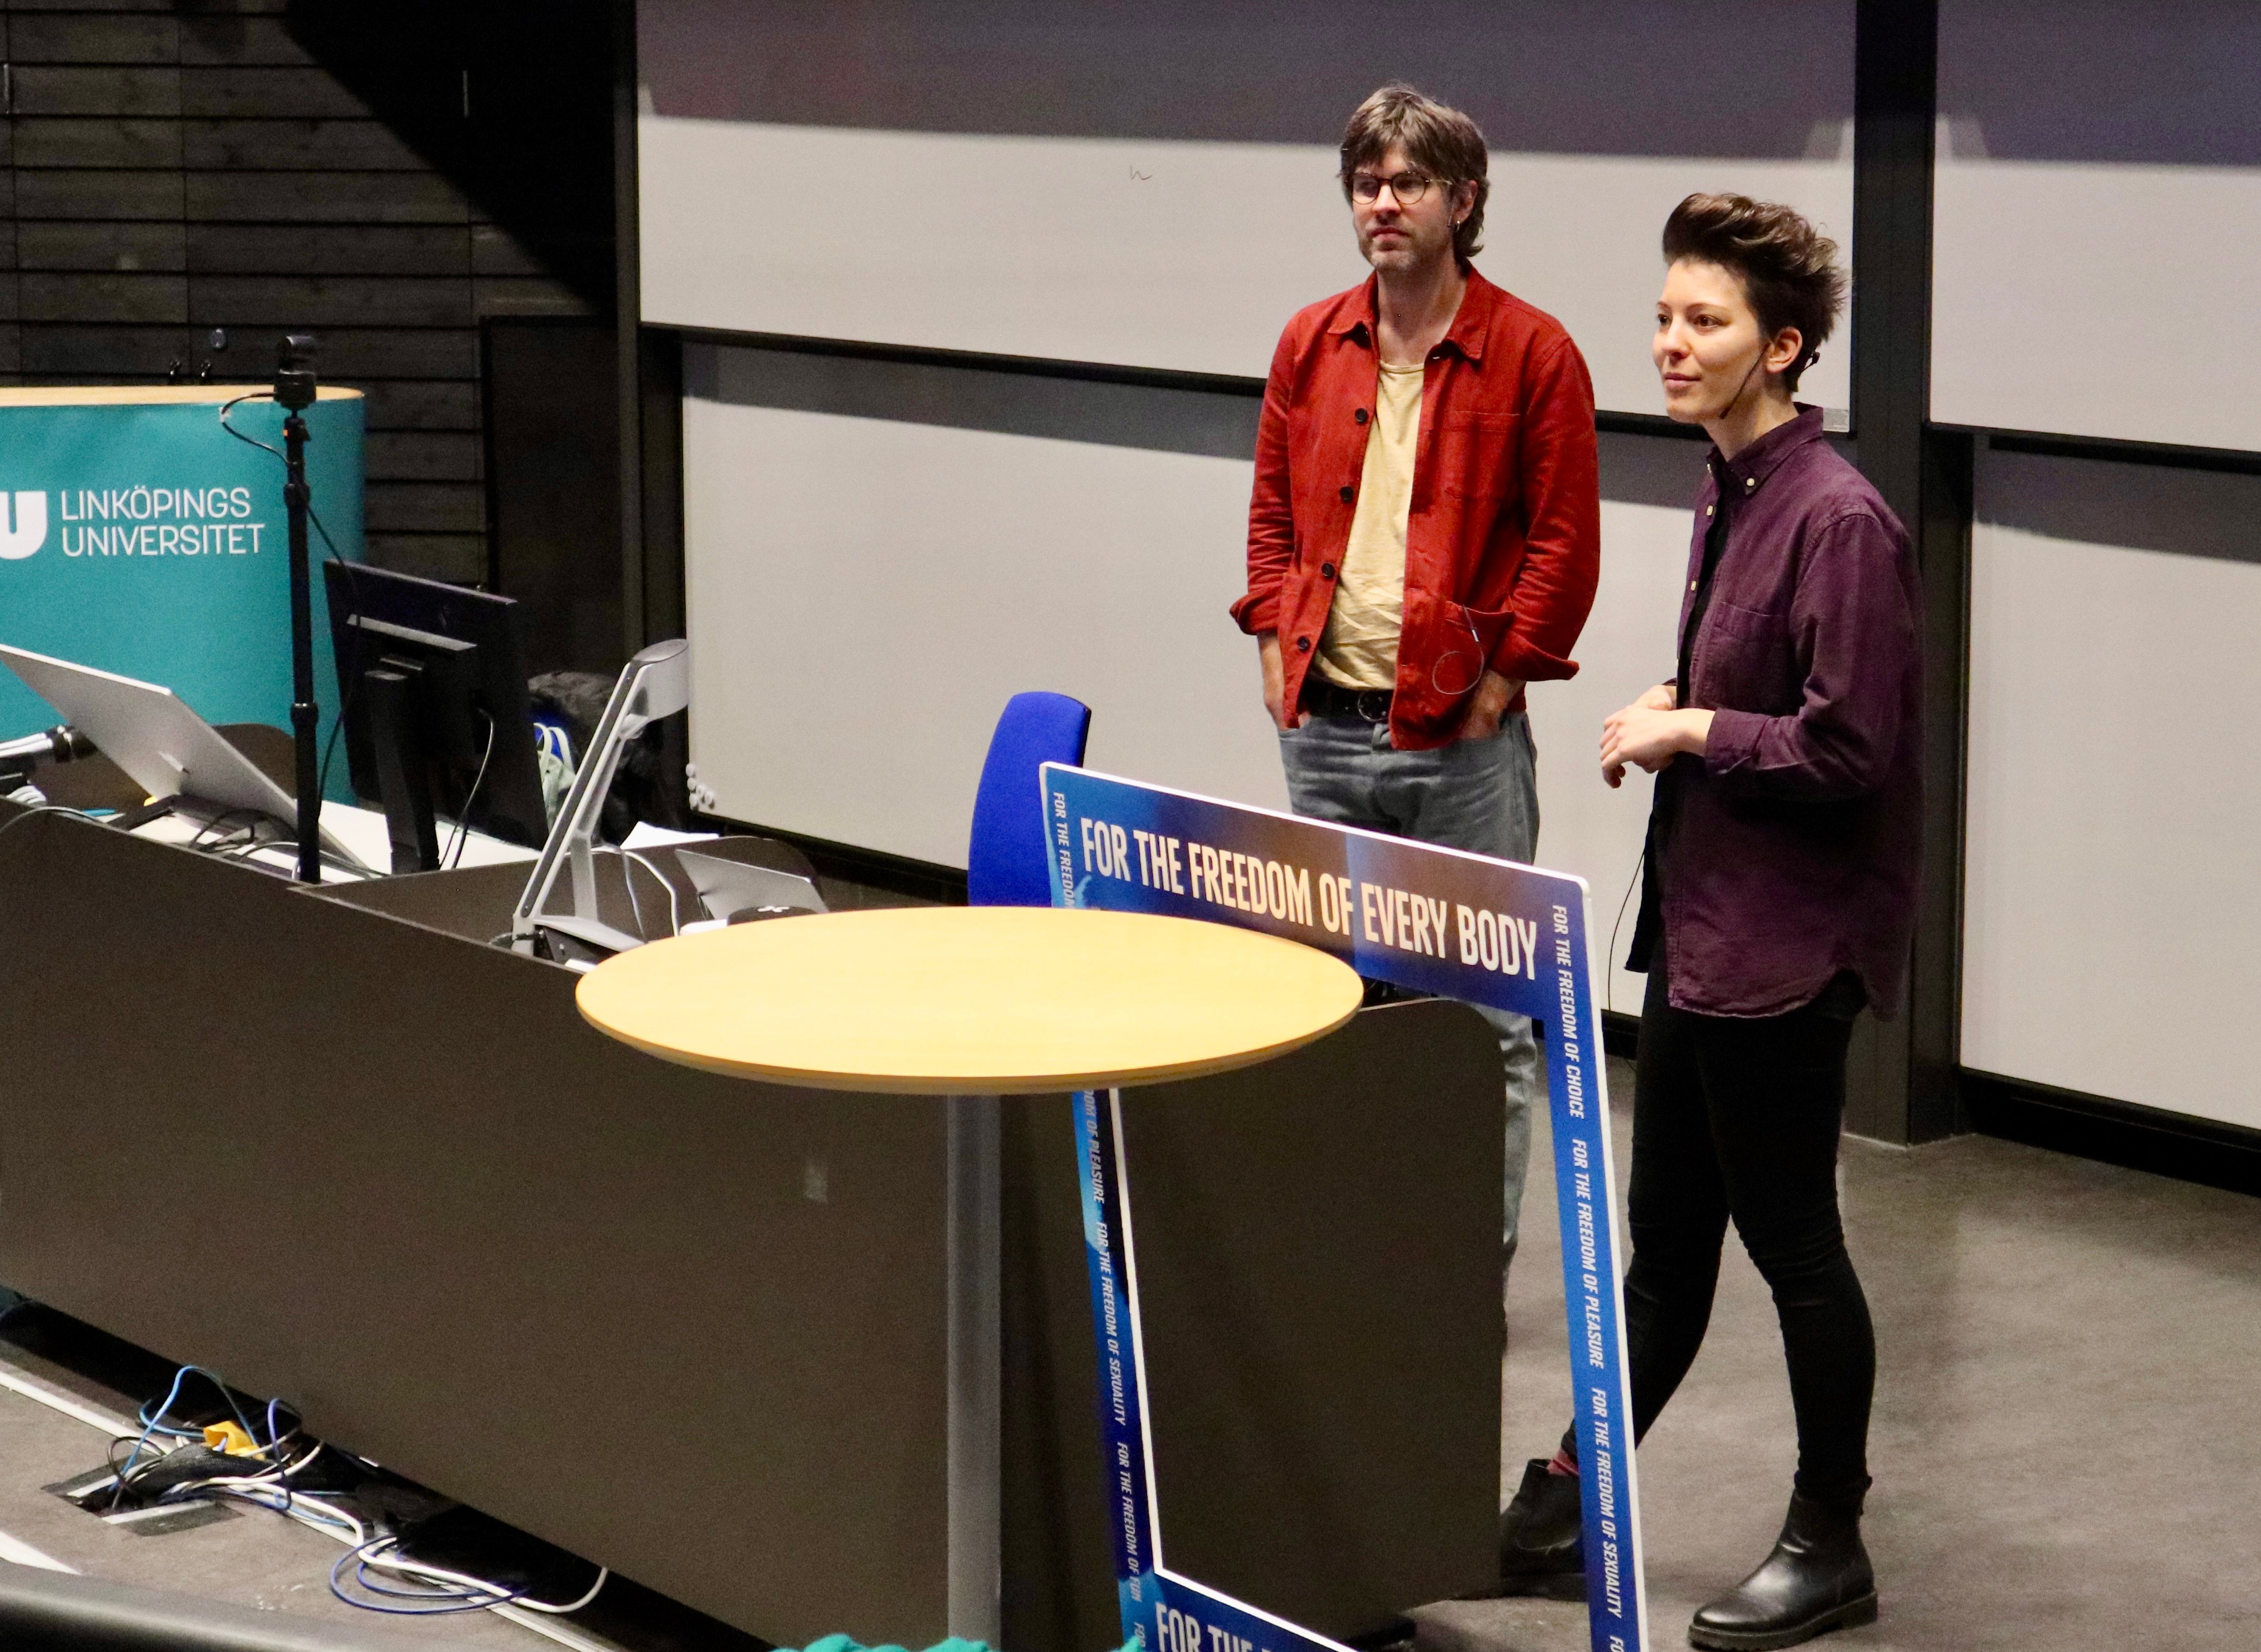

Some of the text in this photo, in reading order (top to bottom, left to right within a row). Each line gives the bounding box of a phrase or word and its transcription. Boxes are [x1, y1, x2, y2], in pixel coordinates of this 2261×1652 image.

[61, 485, 252, 521] LINKÖPINGS
[62, 524, 265, 557] UNIVERSITET
[1054, 792, 1075, 908] FOR THE FREEDOM
[1080, 817, 1537, 980] FOR THE FREEDOM OF EVERY BODY
[1552, 904, 1584, 1119] FOR THE FREEDOM OF CHOICE
[1087, 1120, 1098, 1138] OF
[1089, 1139, 1105, 1204] PLEASURE
[1573, 1139, 1603, 1369] FOR THE FREEDOM OF PLEASURE
[1096, 1222, 1126, 1426] FOR THE FREEDOM OF SEXUALITY
[1117, 1442, 1129, 1468] FOR
[1120, 1472, 1132, 1496] THE
[1122, 1496, 1137, 1556] FREEDOM
[1592, 1387, 1621, 1618] FOR THE FREEDOM OF SEXUALITY
[1128, 1557, 1139, 1575] OF
[1610, 1636, 1624, 1652] FO
